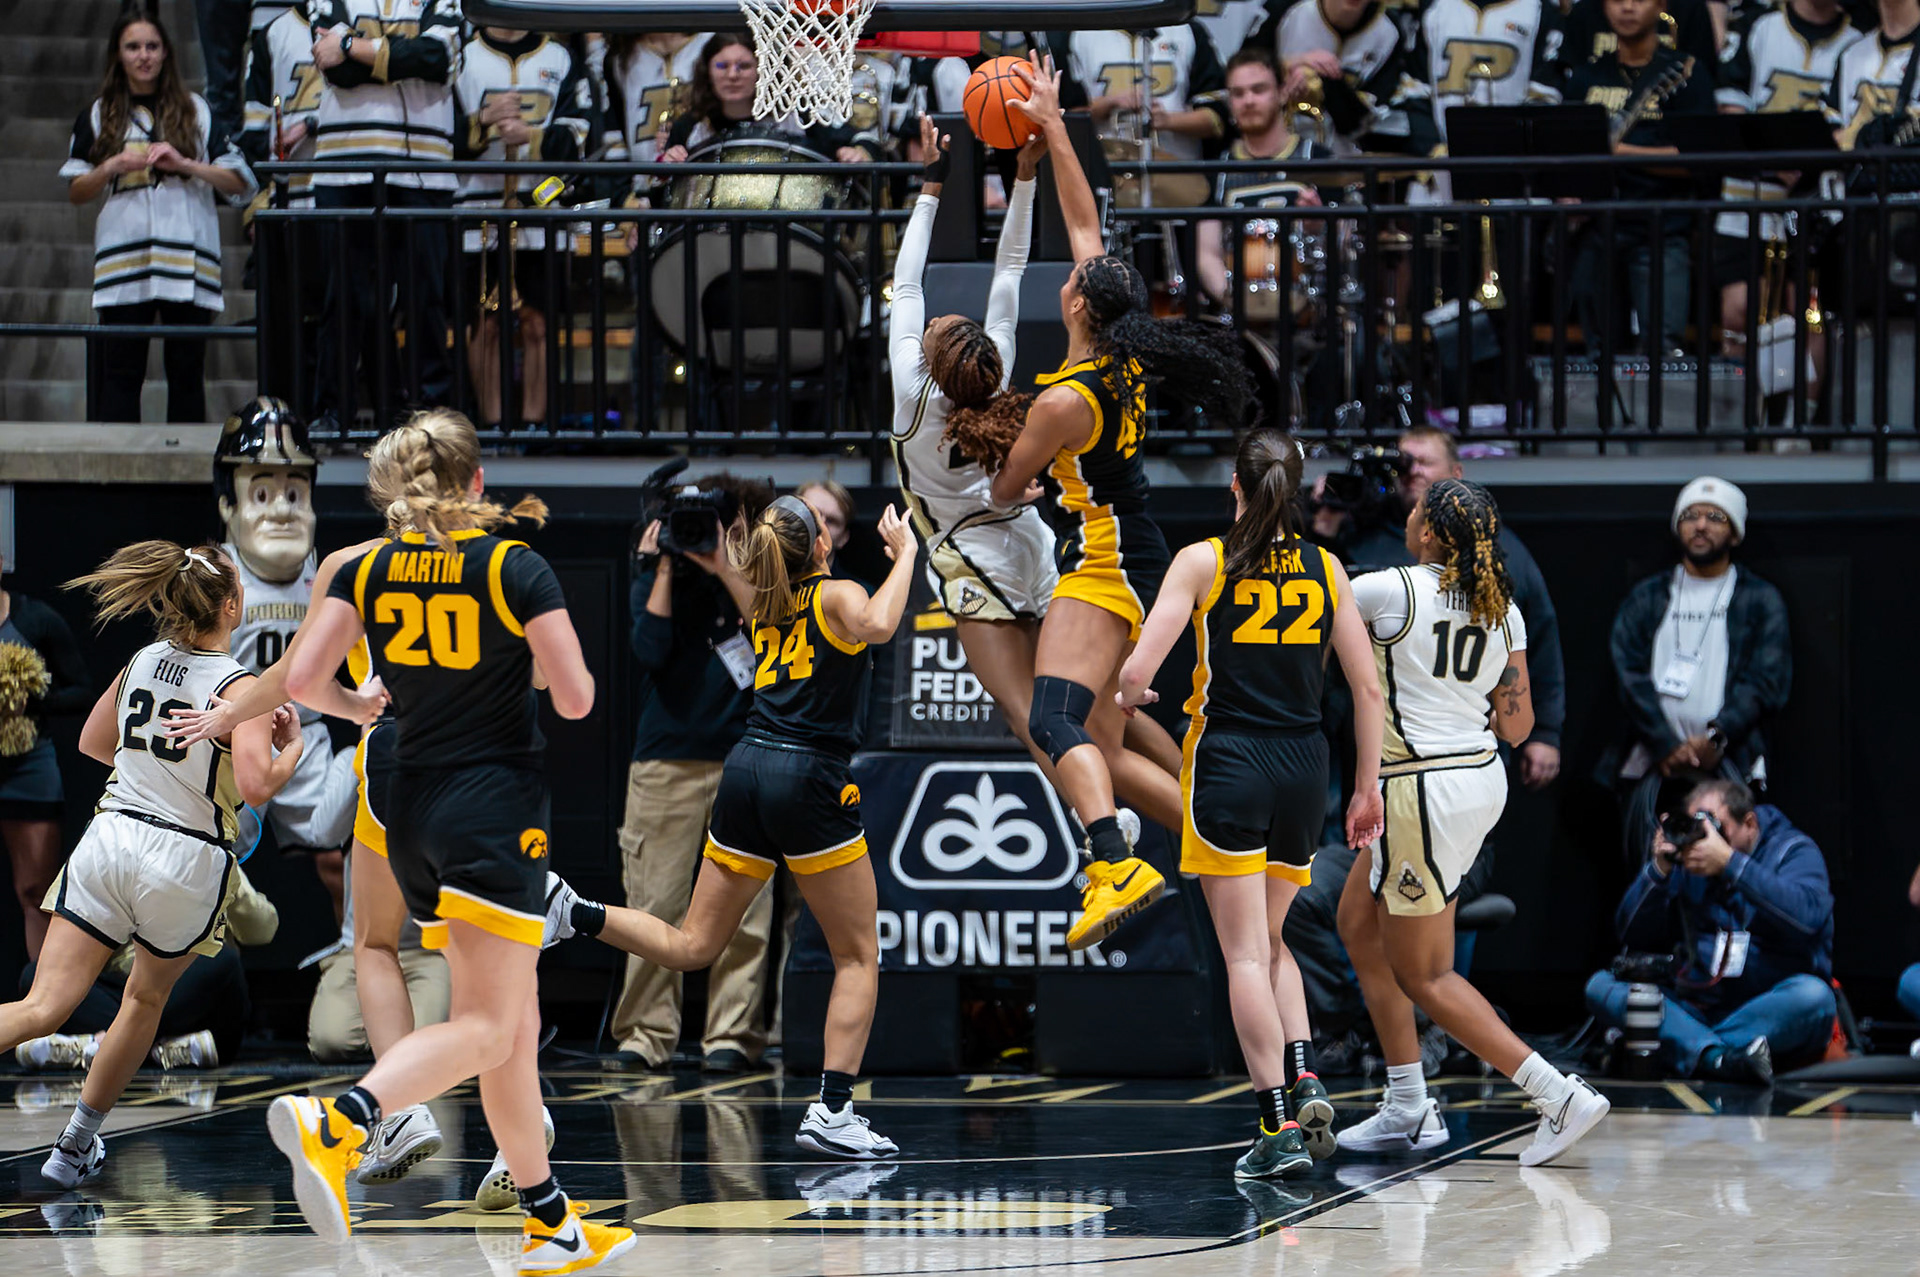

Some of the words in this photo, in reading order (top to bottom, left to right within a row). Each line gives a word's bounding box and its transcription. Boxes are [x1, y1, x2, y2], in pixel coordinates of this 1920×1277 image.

[1437, 38, 1521, 96] P
[387, 551, 465, 584] MARTIN
[246, 603, 309, 625] PURDU
[1232, 578, 1325, 645] 22
[1444, 588, 1472, 613] TERR
[256, 631, 297, 668] 0
[374, 591, 480, 671] 20
[754, 617, 815, 691] 24
[1432, 620, 1488, 683] 10
[153, 658, 189, 687] ELLIS
[910, 671, 995, 703] FED
[123, 687, 194, 763] 23
[909, 702, 995, 722] CREDIT
